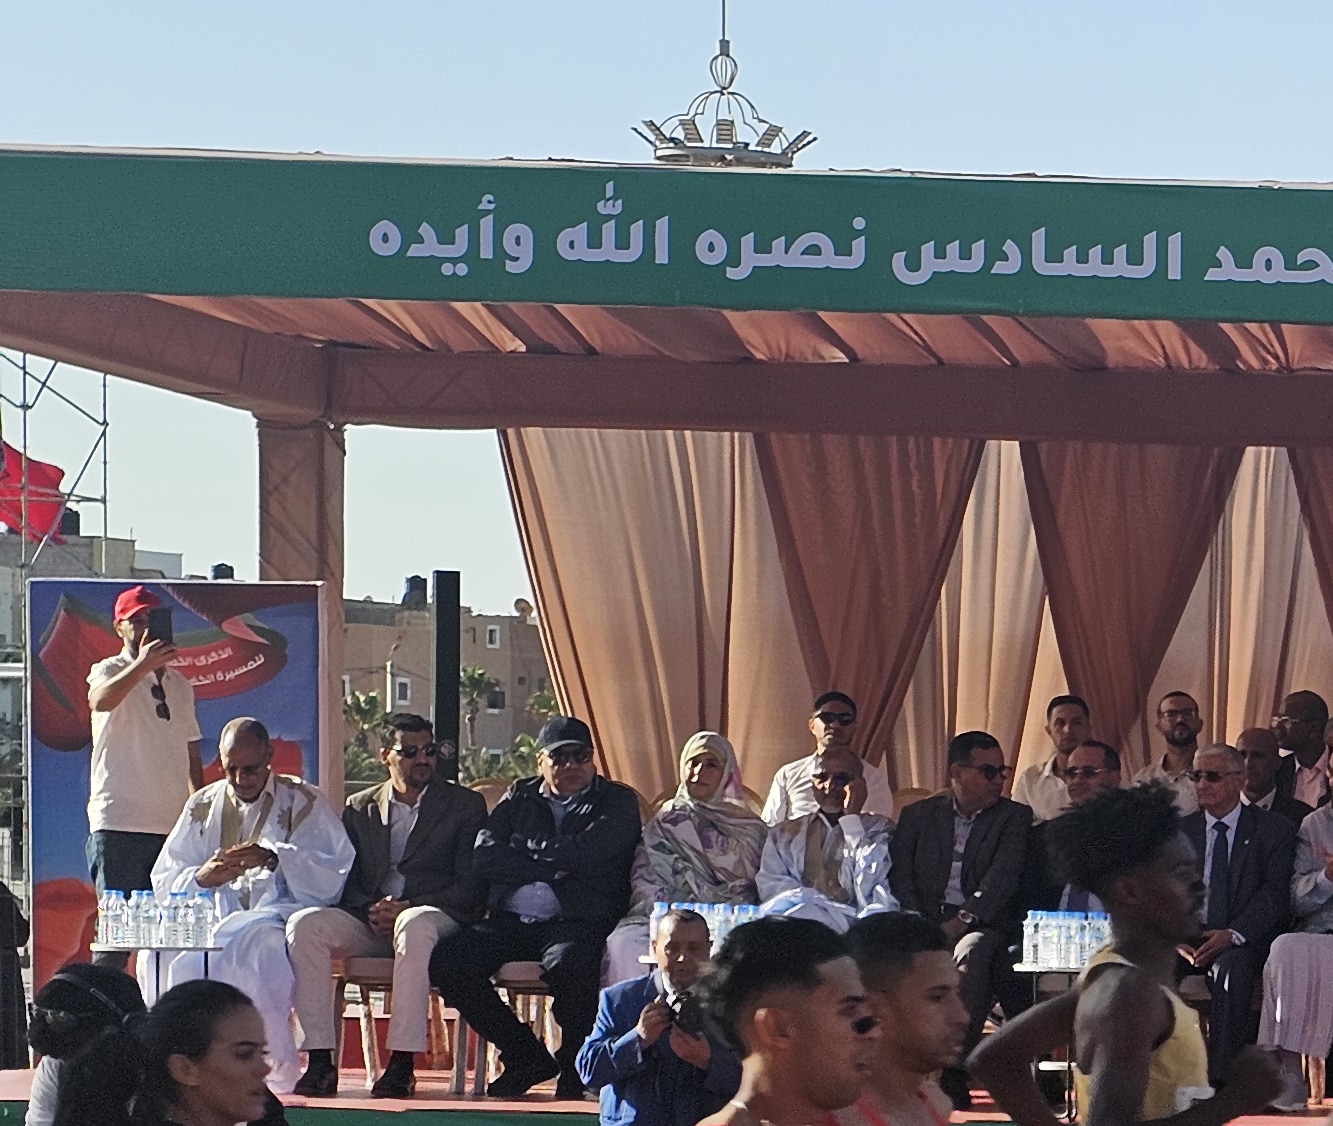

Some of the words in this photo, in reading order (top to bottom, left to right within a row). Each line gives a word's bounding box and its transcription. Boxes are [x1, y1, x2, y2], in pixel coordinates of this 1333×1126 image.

[369, 194, 534, 276] وأيده
[557, 181, 669, 264] الله
[696, 217, 866, 279] نصره
[892, 237, 1182, 284] السادس
